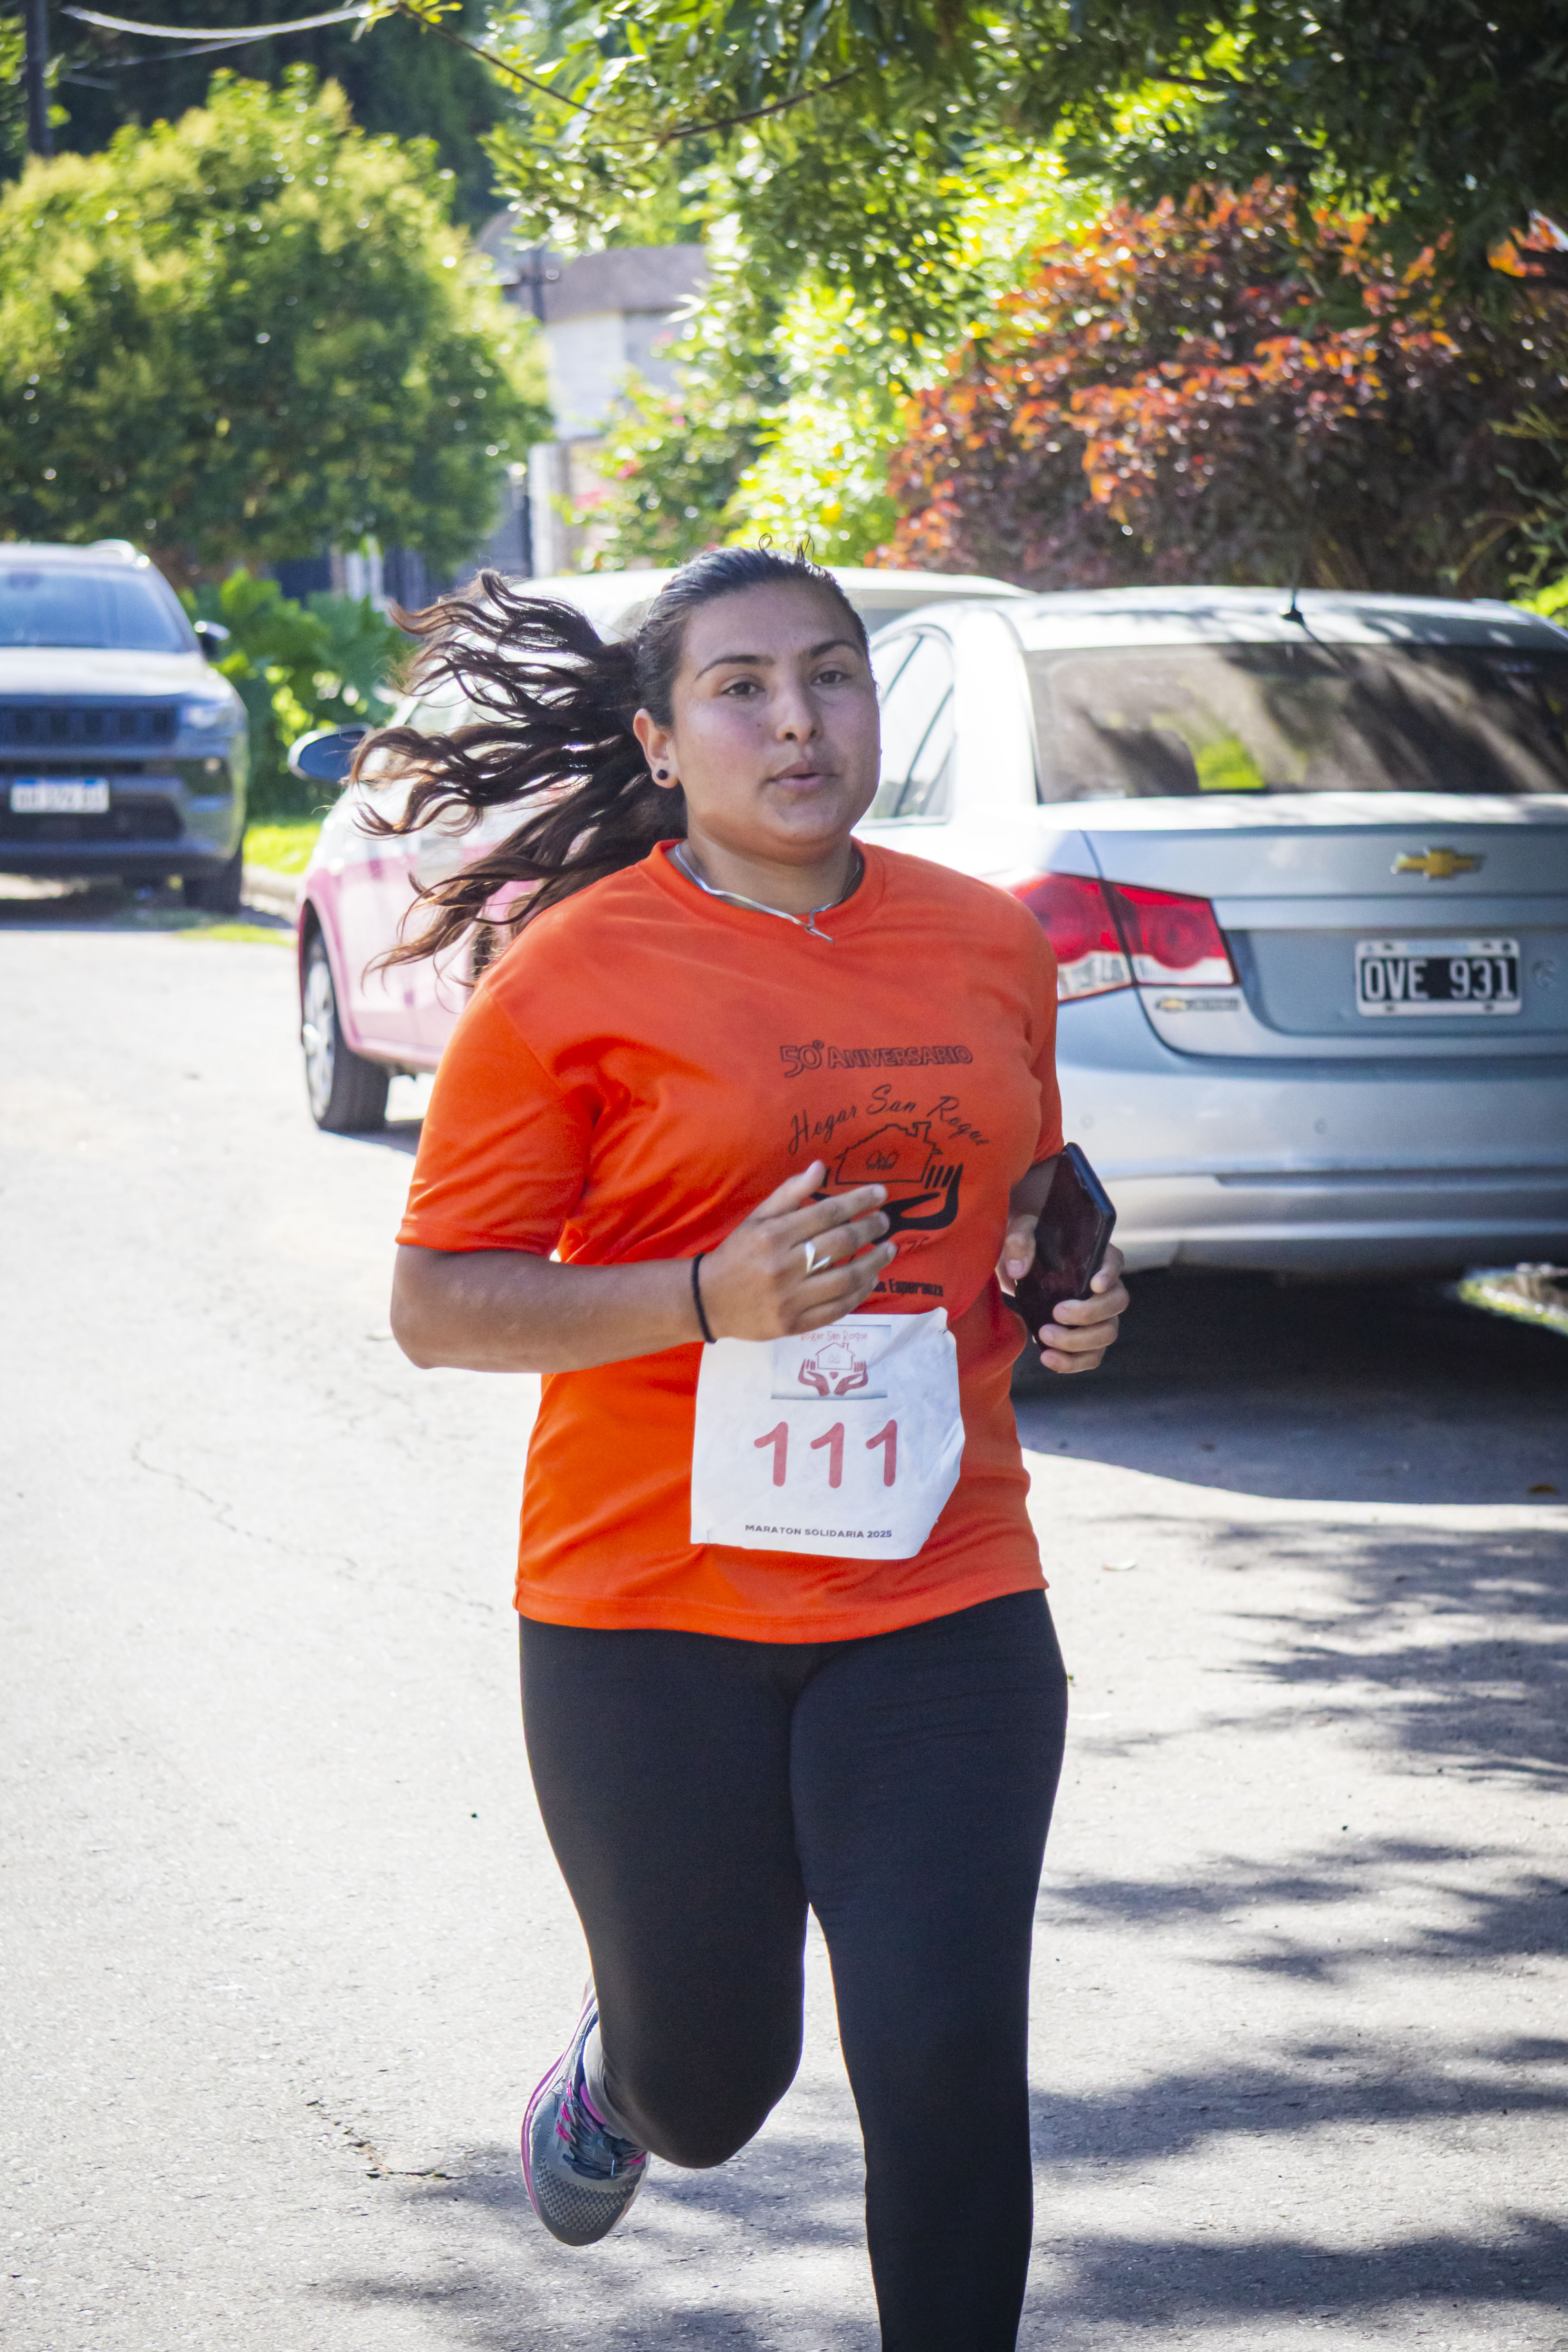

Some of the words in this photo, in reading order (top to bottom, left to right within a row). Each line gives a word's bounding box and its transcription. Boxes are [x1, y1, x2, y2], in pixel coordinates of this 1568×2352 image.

[1364, 959, 1428, 999] OVE
[1450, 959, 1515, 999] 931
[788, 1107, 856, 1155] Hogar
[867, 1084, 916, 1115] San
[927, 1096, 989, 1146] Roque
[827, 1330, 841, 1341] San
[843, 1330, 868, 1341] Roque
[754, 1419, 898, 1489] 111
[745, 1524, 802, 1535] MARATON
[804, 1528, 864, 1538] SOLIDARIA
[867, 1530, 892, 1539] 2025
